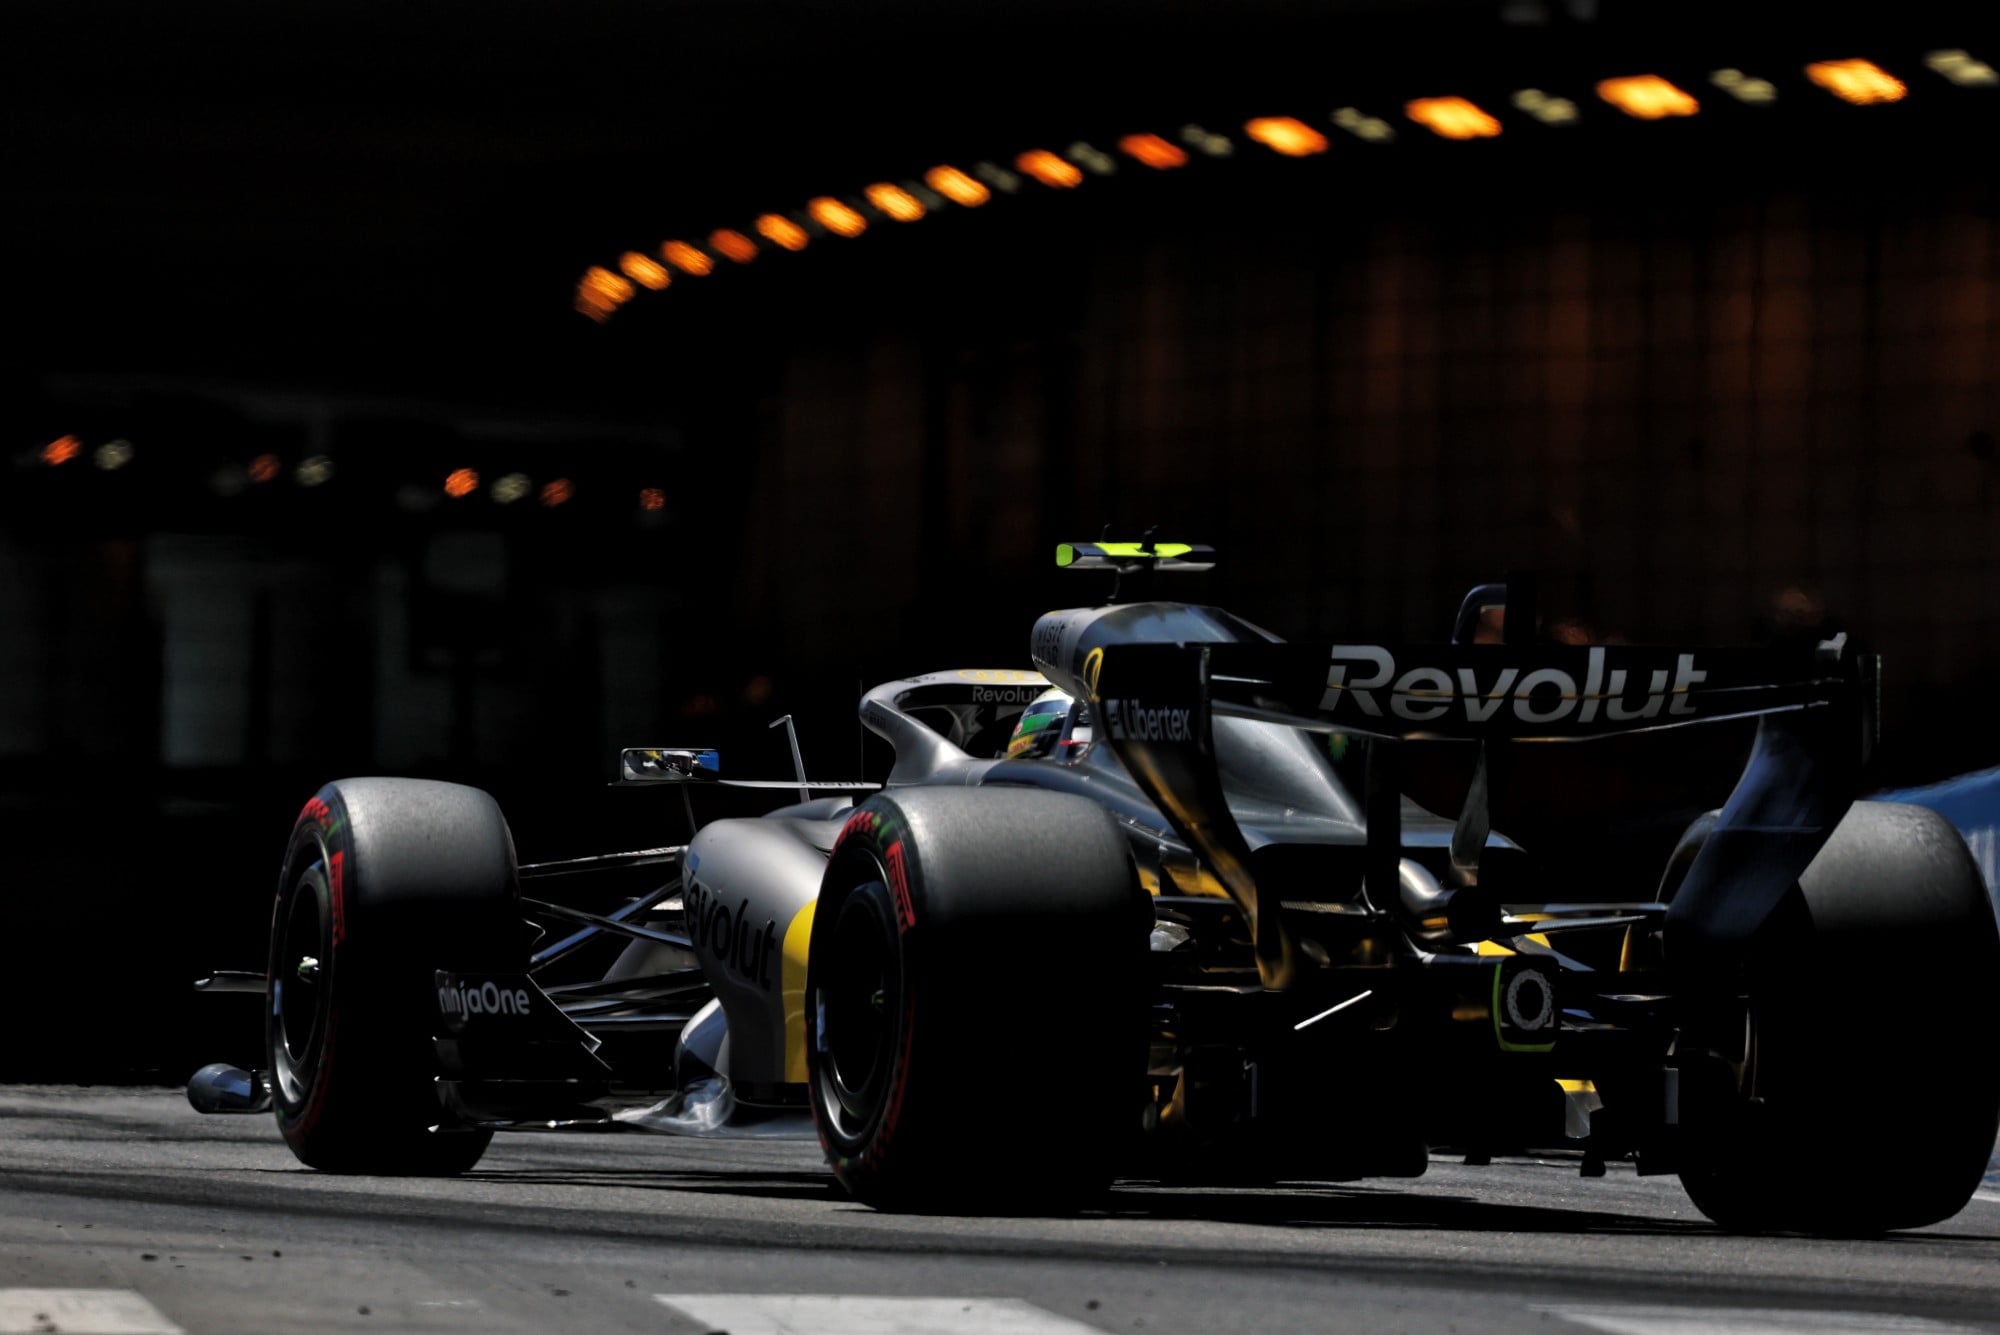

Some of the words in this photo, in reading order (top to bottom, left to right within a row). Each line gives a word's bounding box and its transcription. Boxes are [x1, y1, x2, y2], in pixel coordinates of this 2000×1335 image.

[1320, 643, 1708, 723] Revolut
[1122, 698, 1192, 742] Libertex
[686, 870, 776, 991] evolut
[438, 979, 530, 1022] ninjaOne
